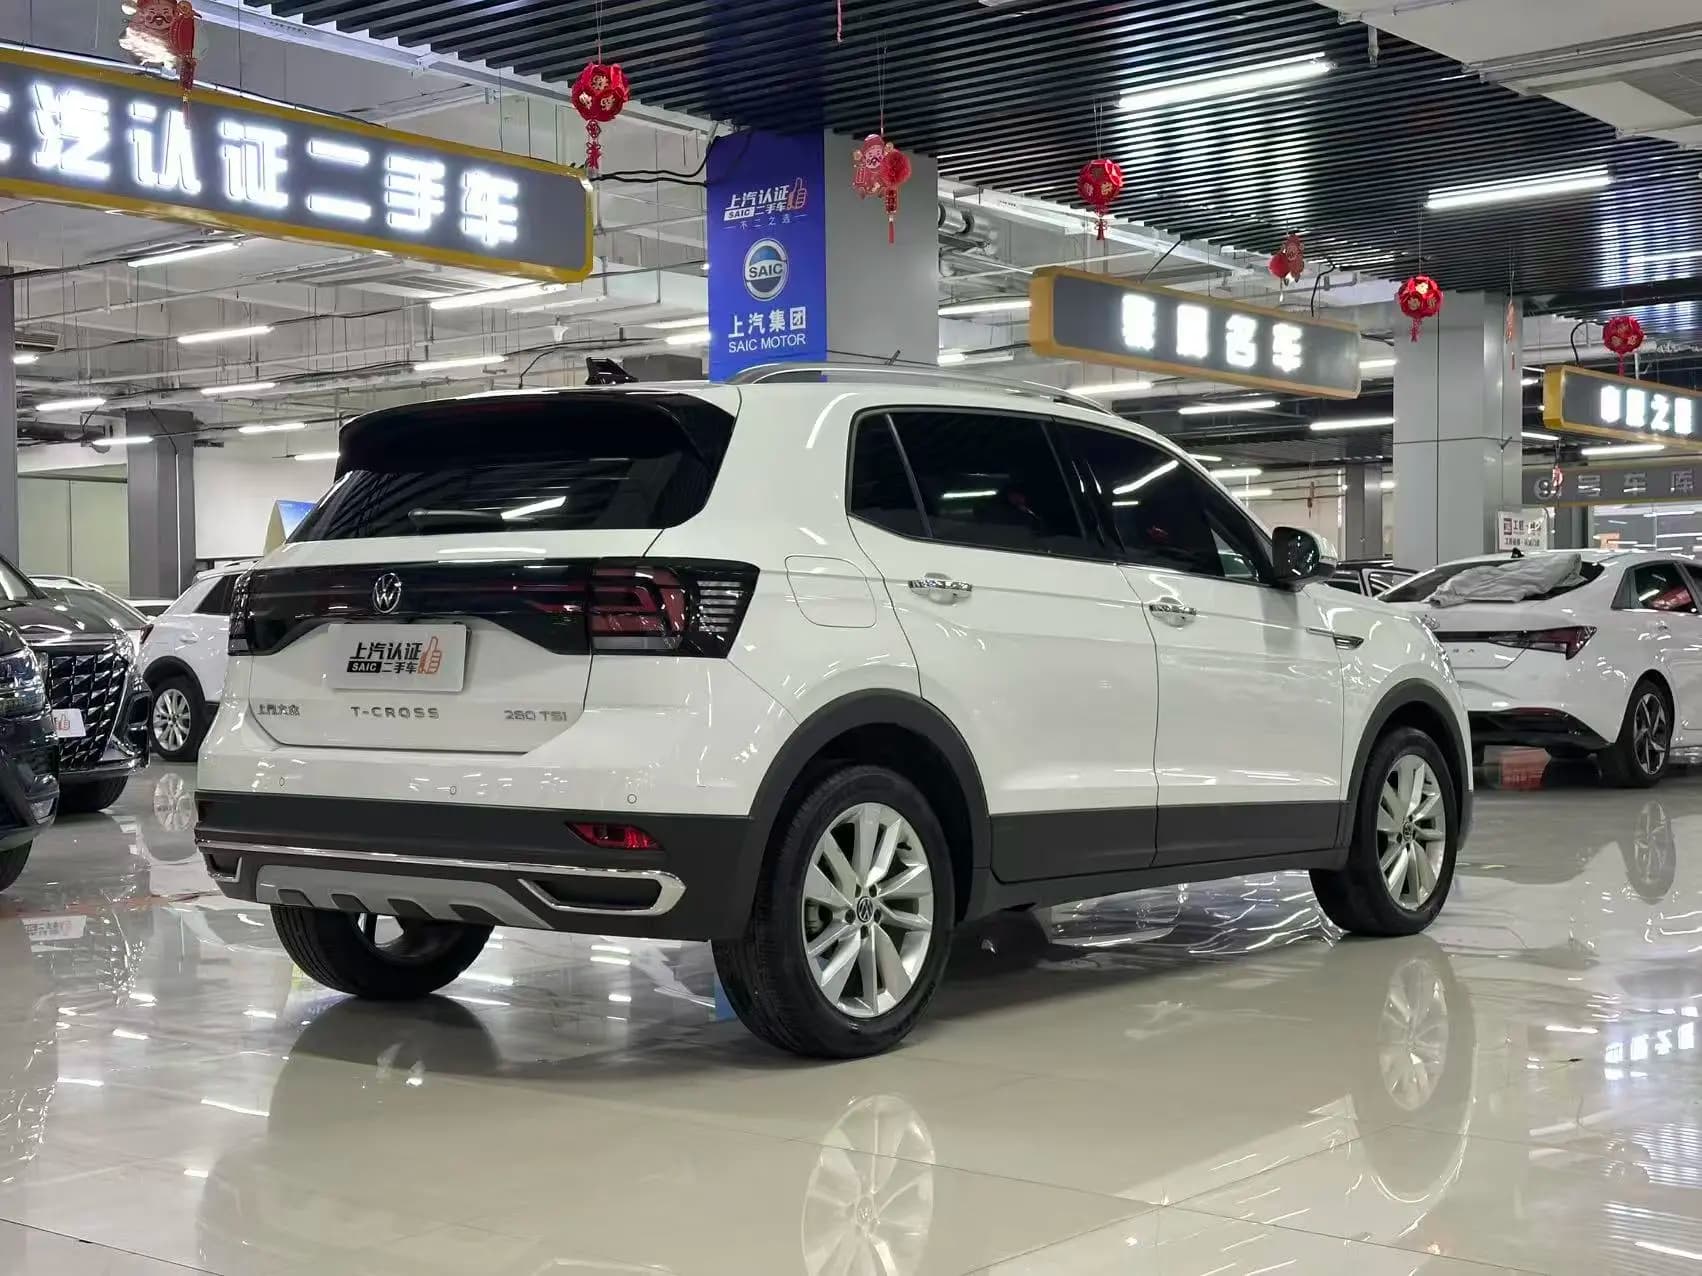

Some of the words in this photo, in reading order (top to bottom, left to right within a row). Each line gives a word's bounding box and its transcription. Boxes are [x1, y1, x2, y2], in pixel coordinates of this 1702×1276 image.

[725, 185, 789, 210] 上汽认证
[726, 208, 752, 219] SAIC
[754, 201, 786, 215] 二手车
[748, 263, 783, 279] SAIC
[728, 306, 806, 338] 上汽集团
[728, 338, 757, 353] SAIC
[761, 333, 807, 349] MOTOR
[349, 641, 423, 660] 上汽认证
[351, 662, 378, 672] SAIC
[381, 661, 419, 674] 二手车
[350, 706, 439, 719] T-CROSS
[504, 709, 536, 721] 280
[539, 710, 568, 721] TSI
